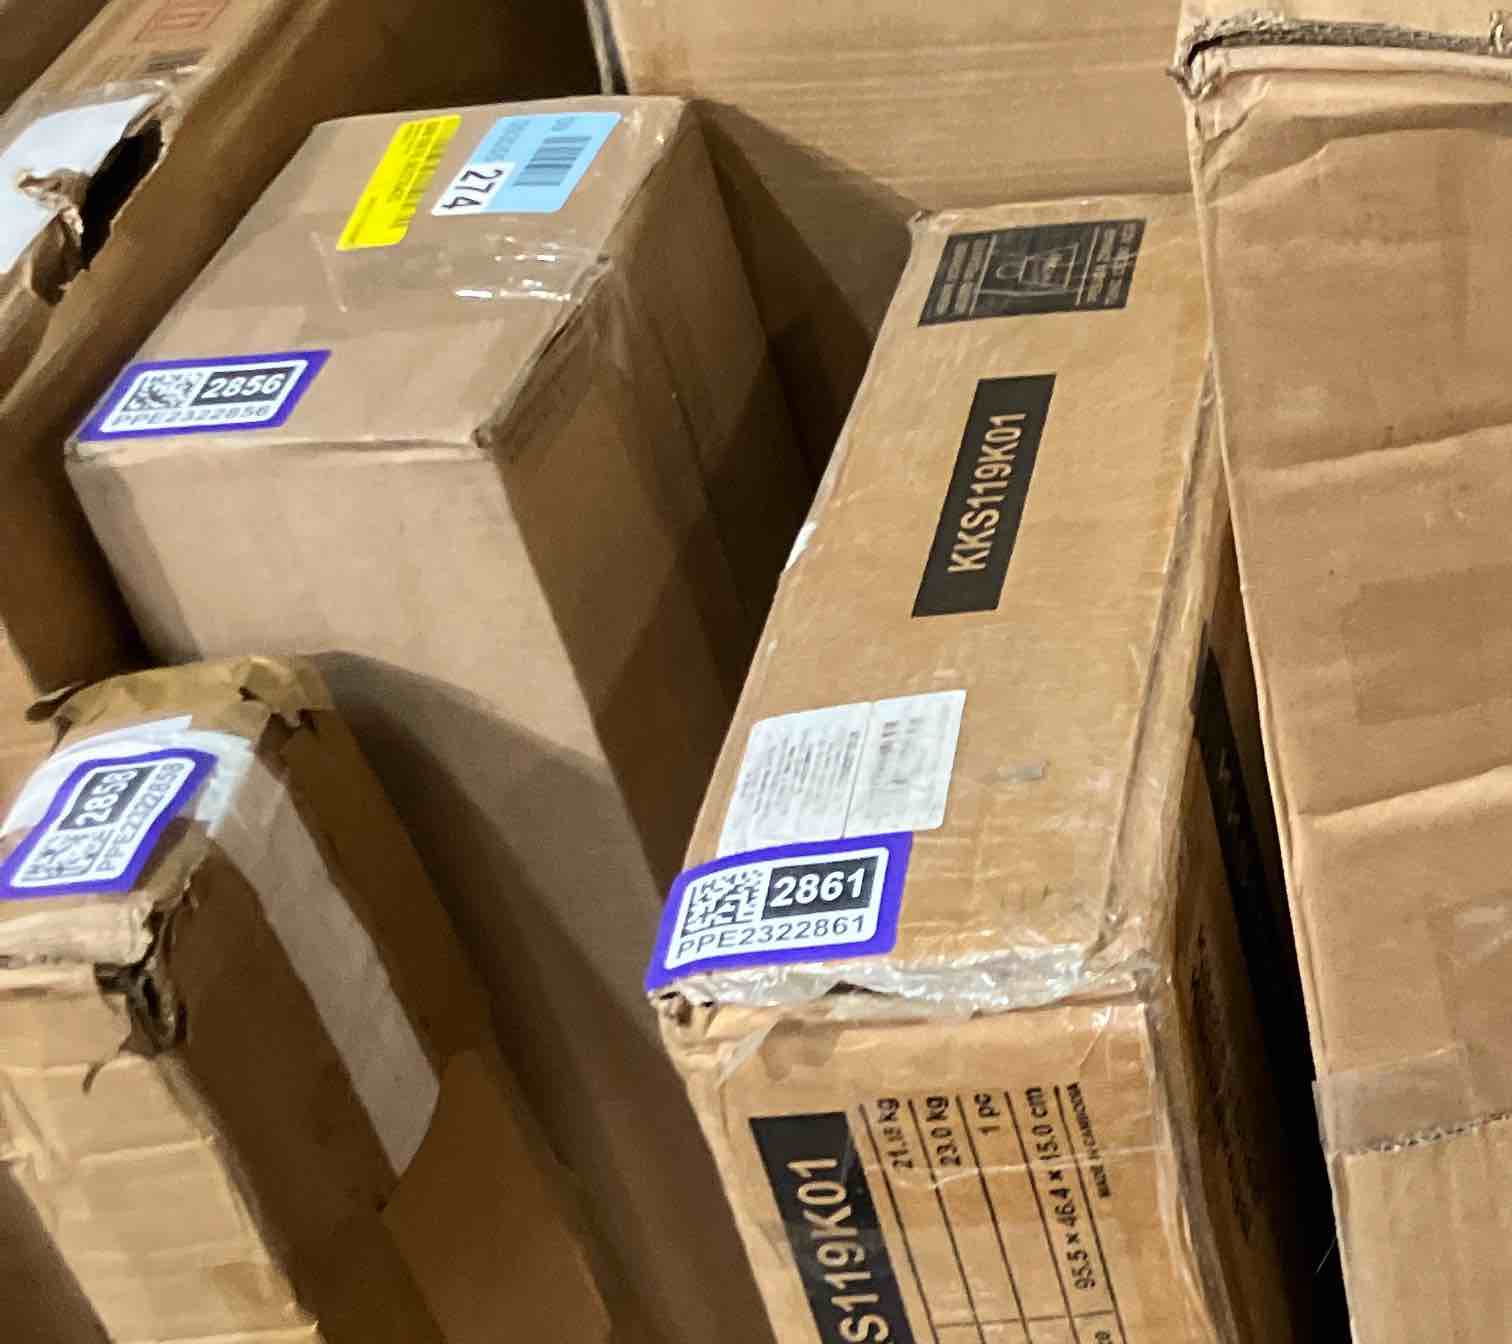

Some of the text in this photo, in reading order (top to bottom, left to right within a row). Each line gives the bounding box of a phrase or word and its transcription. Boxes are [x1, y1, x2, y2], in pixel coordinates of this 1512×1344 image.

[438, 167, 506, 210] 274
[200, 373, 287, 400] 2856
[112, 403, 274, 426] PPE2322856
[948, 409, 1027, 573] KKS119K01
[74, 768, 139, 828] 2858
[769, 867, 866, 908] 2861
[677, 913, 866, 959] PPE2322861
[876, 1097, 901, 1123] kg
[925, 1095, 950, 1123] kg
[974, 1092, 1001, 1119] pc
[1025, 1087, 1049, 1120] cm
[980, 1125, 999, 1136] 1
